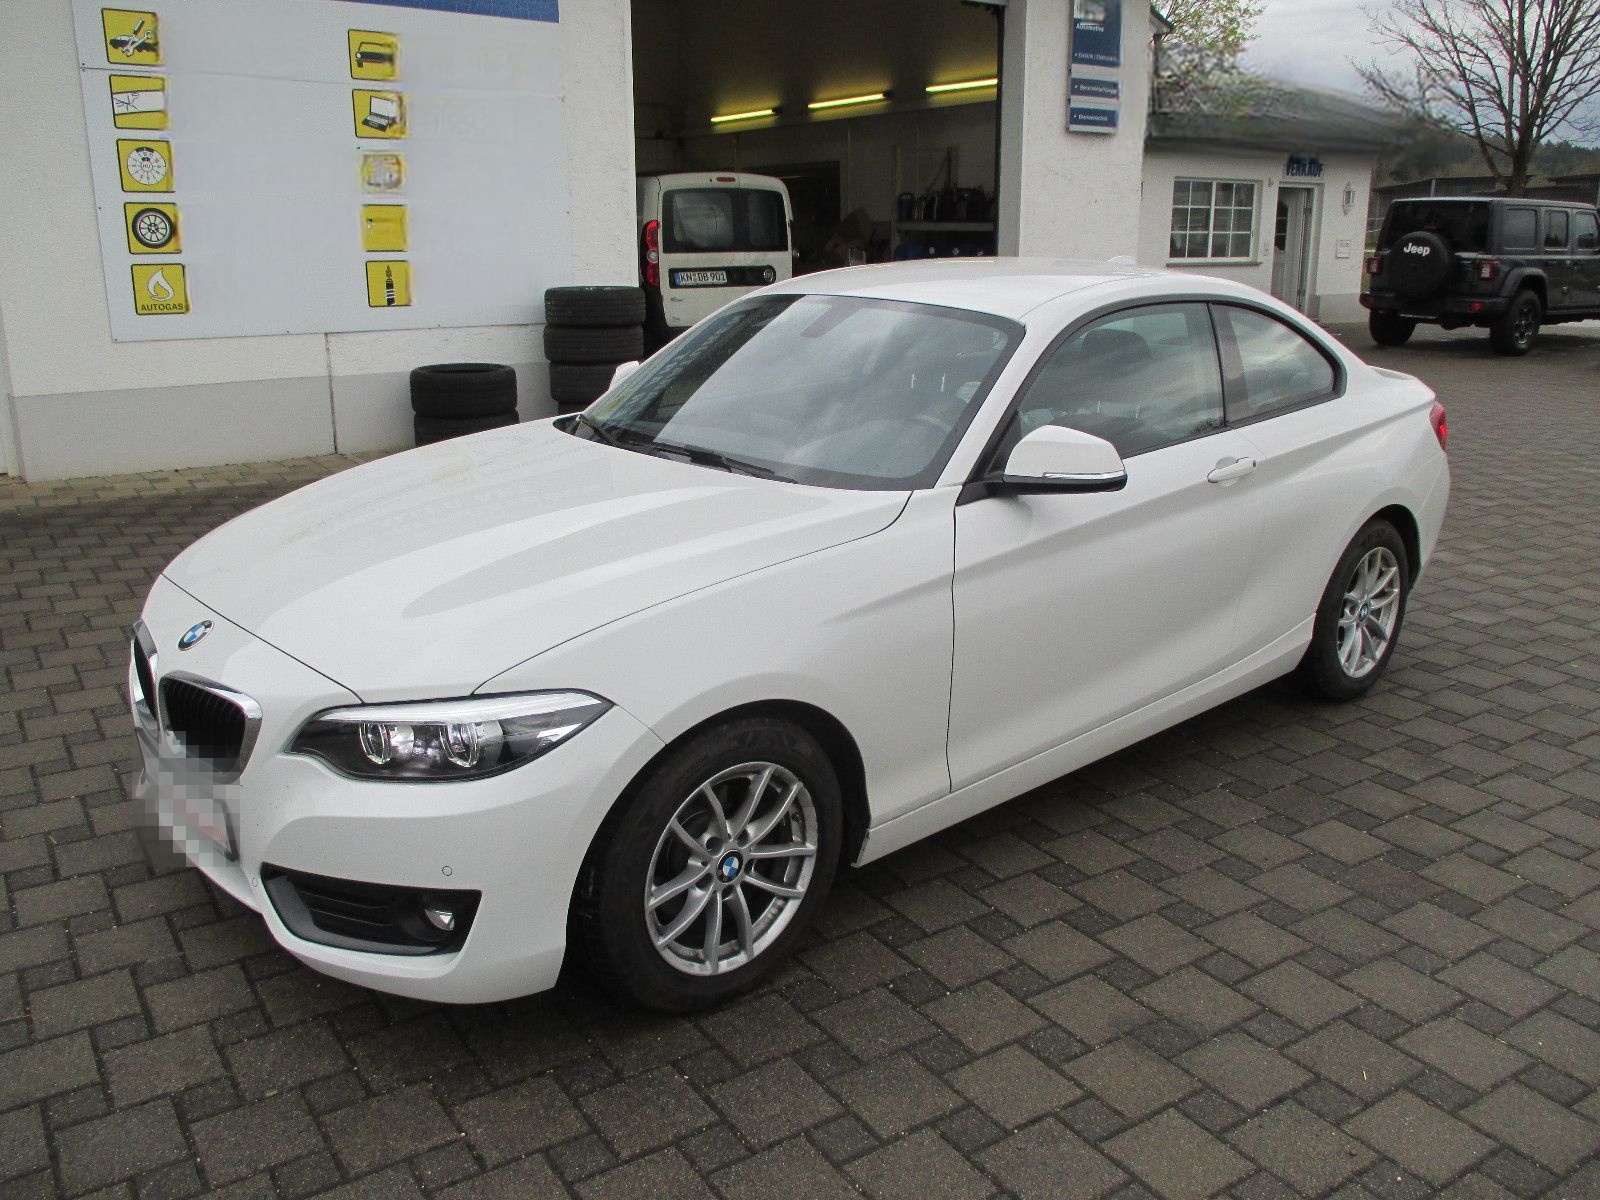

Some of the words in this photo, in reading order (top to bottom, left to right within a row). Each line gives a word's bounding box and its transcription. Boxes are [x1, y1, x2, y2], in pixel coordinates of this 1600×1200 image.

[1403, 242, 1431, 257] Jeep
[680, 273, 693, 283] KN
[697, 272, 708, 282] DB
[710, 271, 727, 281] 901
[141, 303, 184, 312] AUTOGAS
